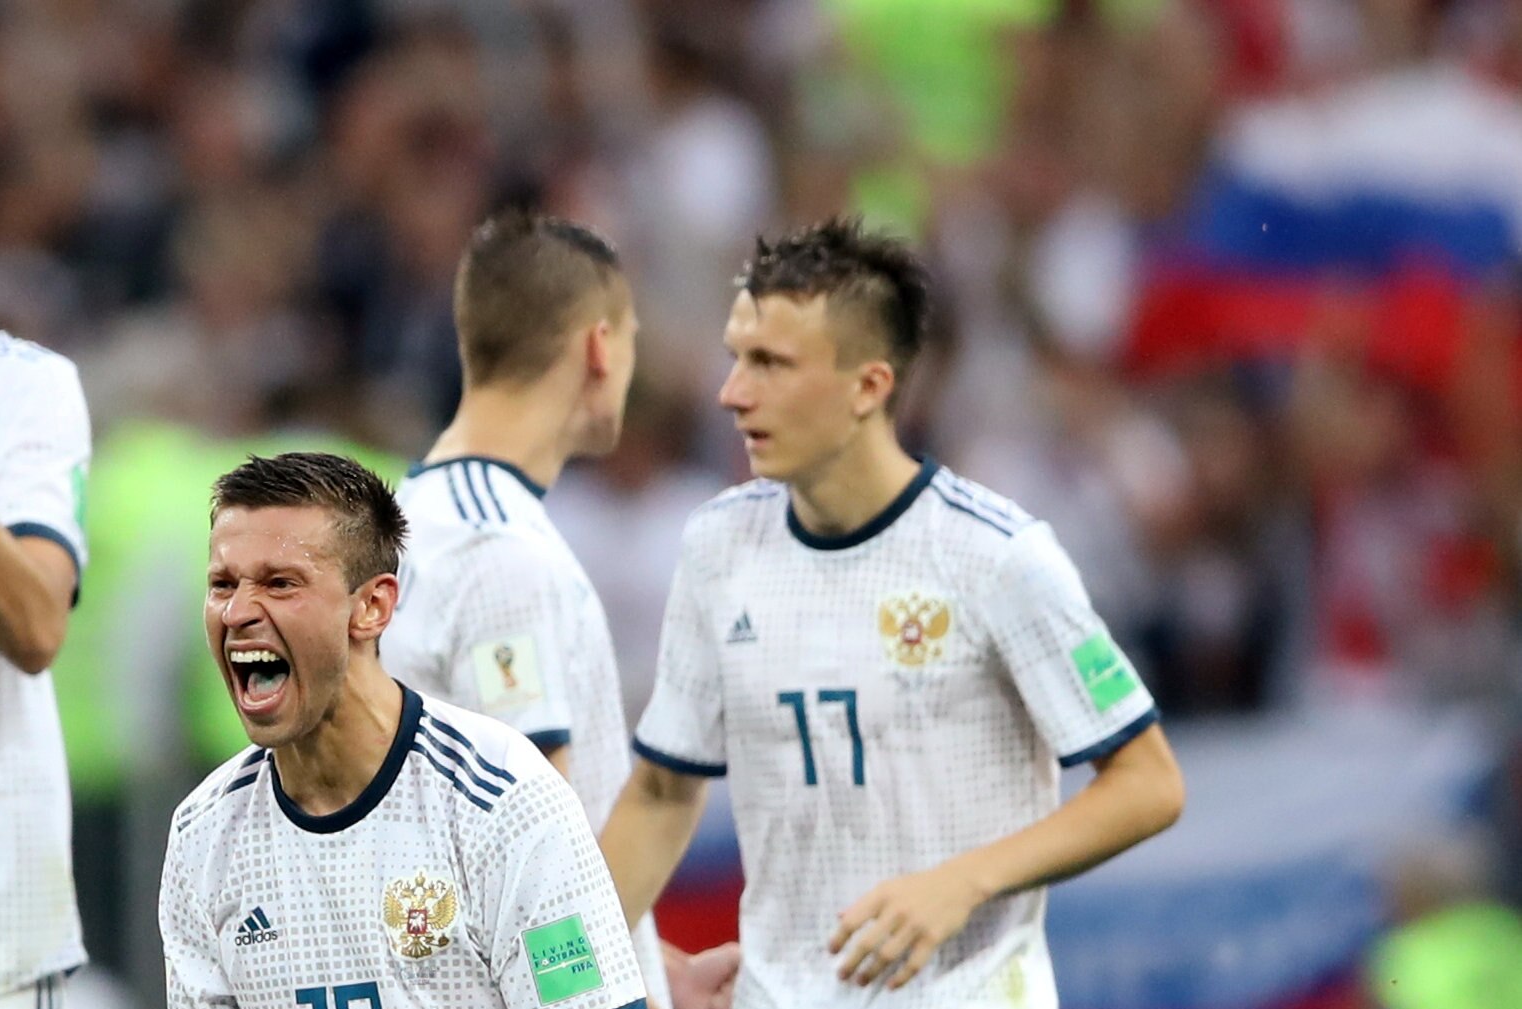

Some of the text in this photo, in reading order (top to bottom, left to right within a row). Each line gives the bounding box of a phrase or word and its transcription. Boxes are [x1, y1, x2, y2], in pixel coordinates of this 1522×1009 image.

[777, 689, 865, 786] 17
[234, 930, 278, 946] adidas
[532, 936, 585, 960] LIVING
[571, 960, 594, 974] FIFA
